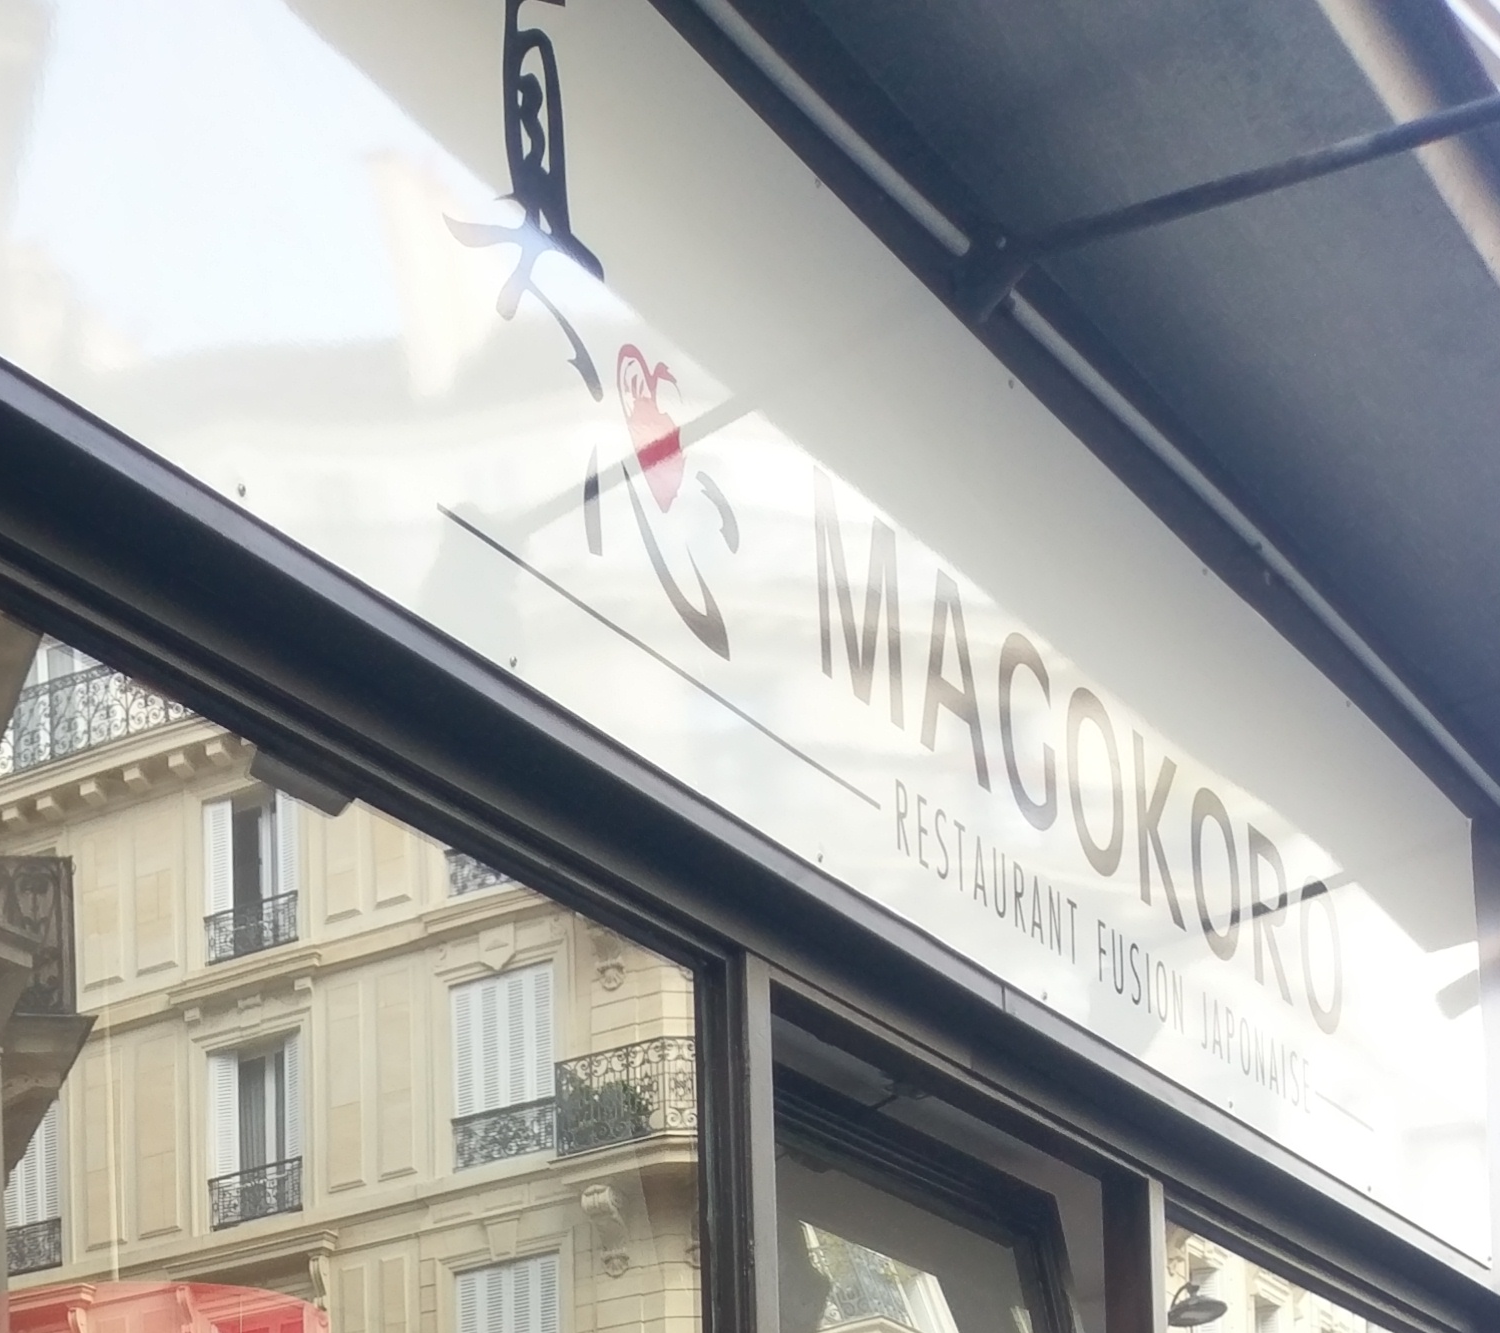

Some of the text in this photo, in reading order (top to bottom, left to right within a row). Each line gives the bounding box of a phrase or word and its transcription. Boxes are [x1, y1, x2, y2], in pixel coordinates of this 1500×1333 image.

[814, 468, 1342, 1034] MAGOKORO
[895, 779, 1311, 1114] RESTAURANT FUSION JAPONAISE
